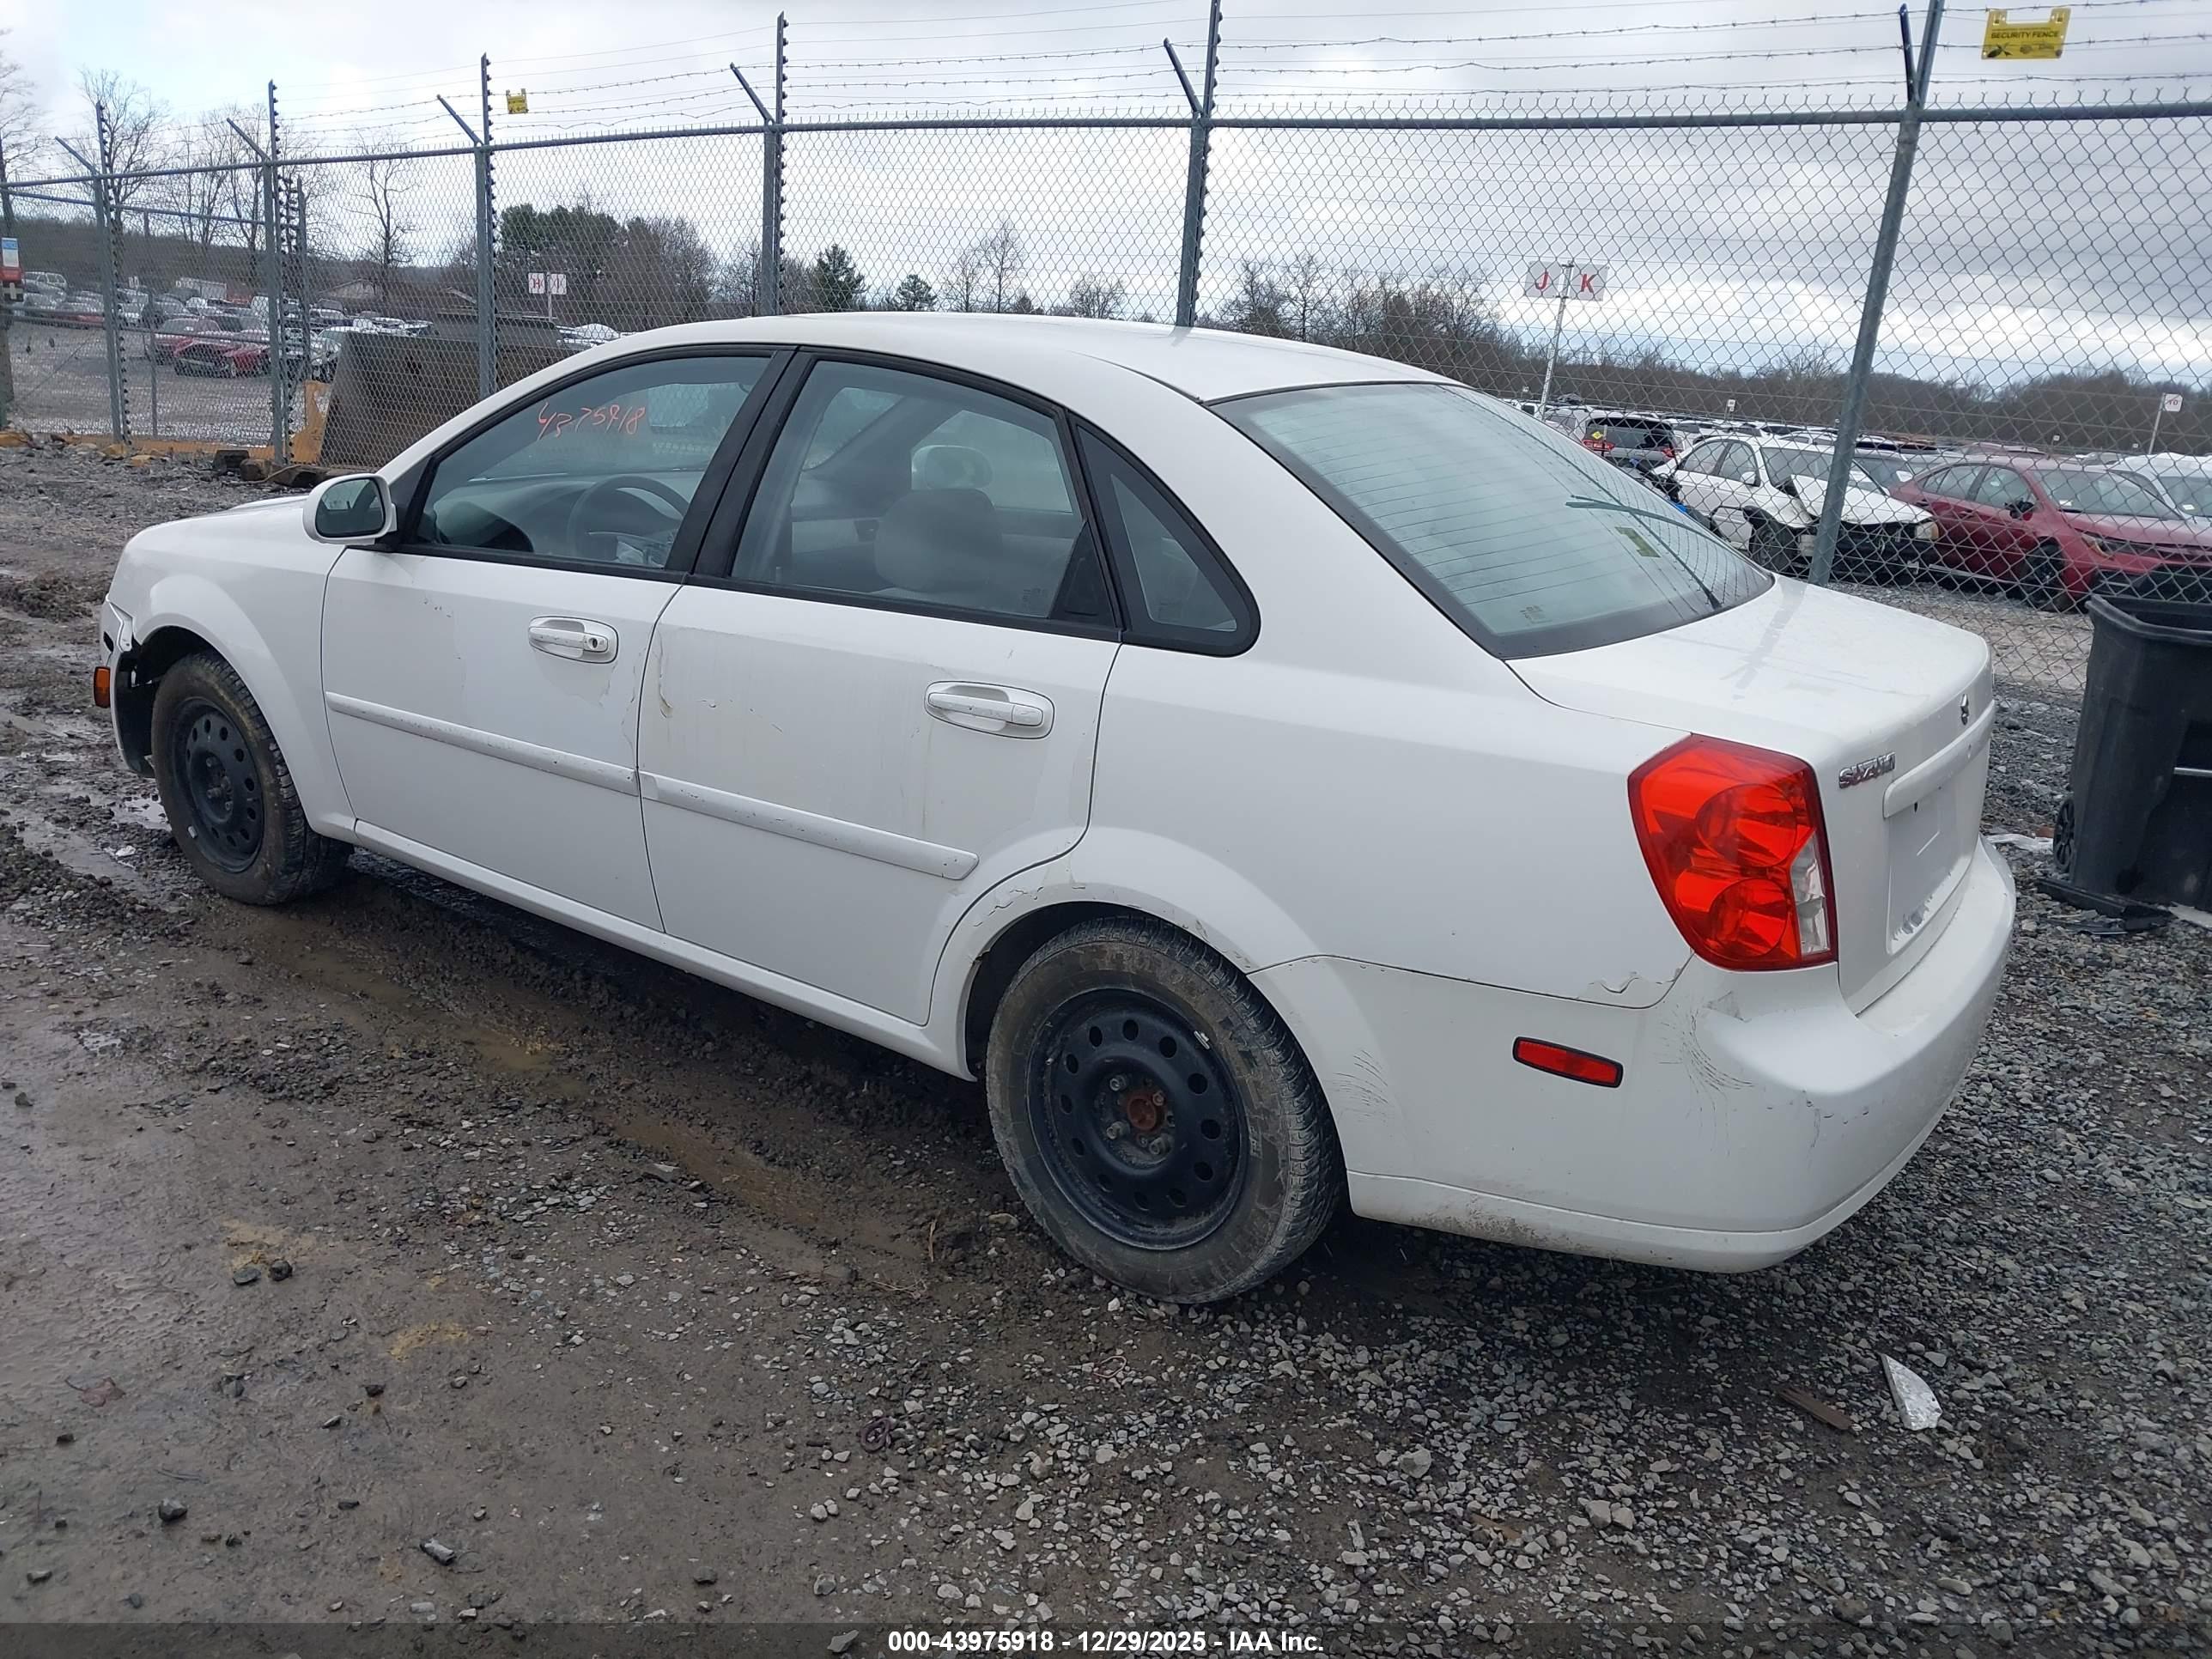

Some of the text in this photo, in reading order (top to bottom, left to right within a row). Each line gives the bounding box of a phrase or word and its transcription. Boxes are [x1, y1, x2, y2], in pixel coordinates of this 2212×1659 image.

[532, 278, 540, 289] H
[1534, 270, 1548, 290] J
[1580, 273, 1598, 294] K
